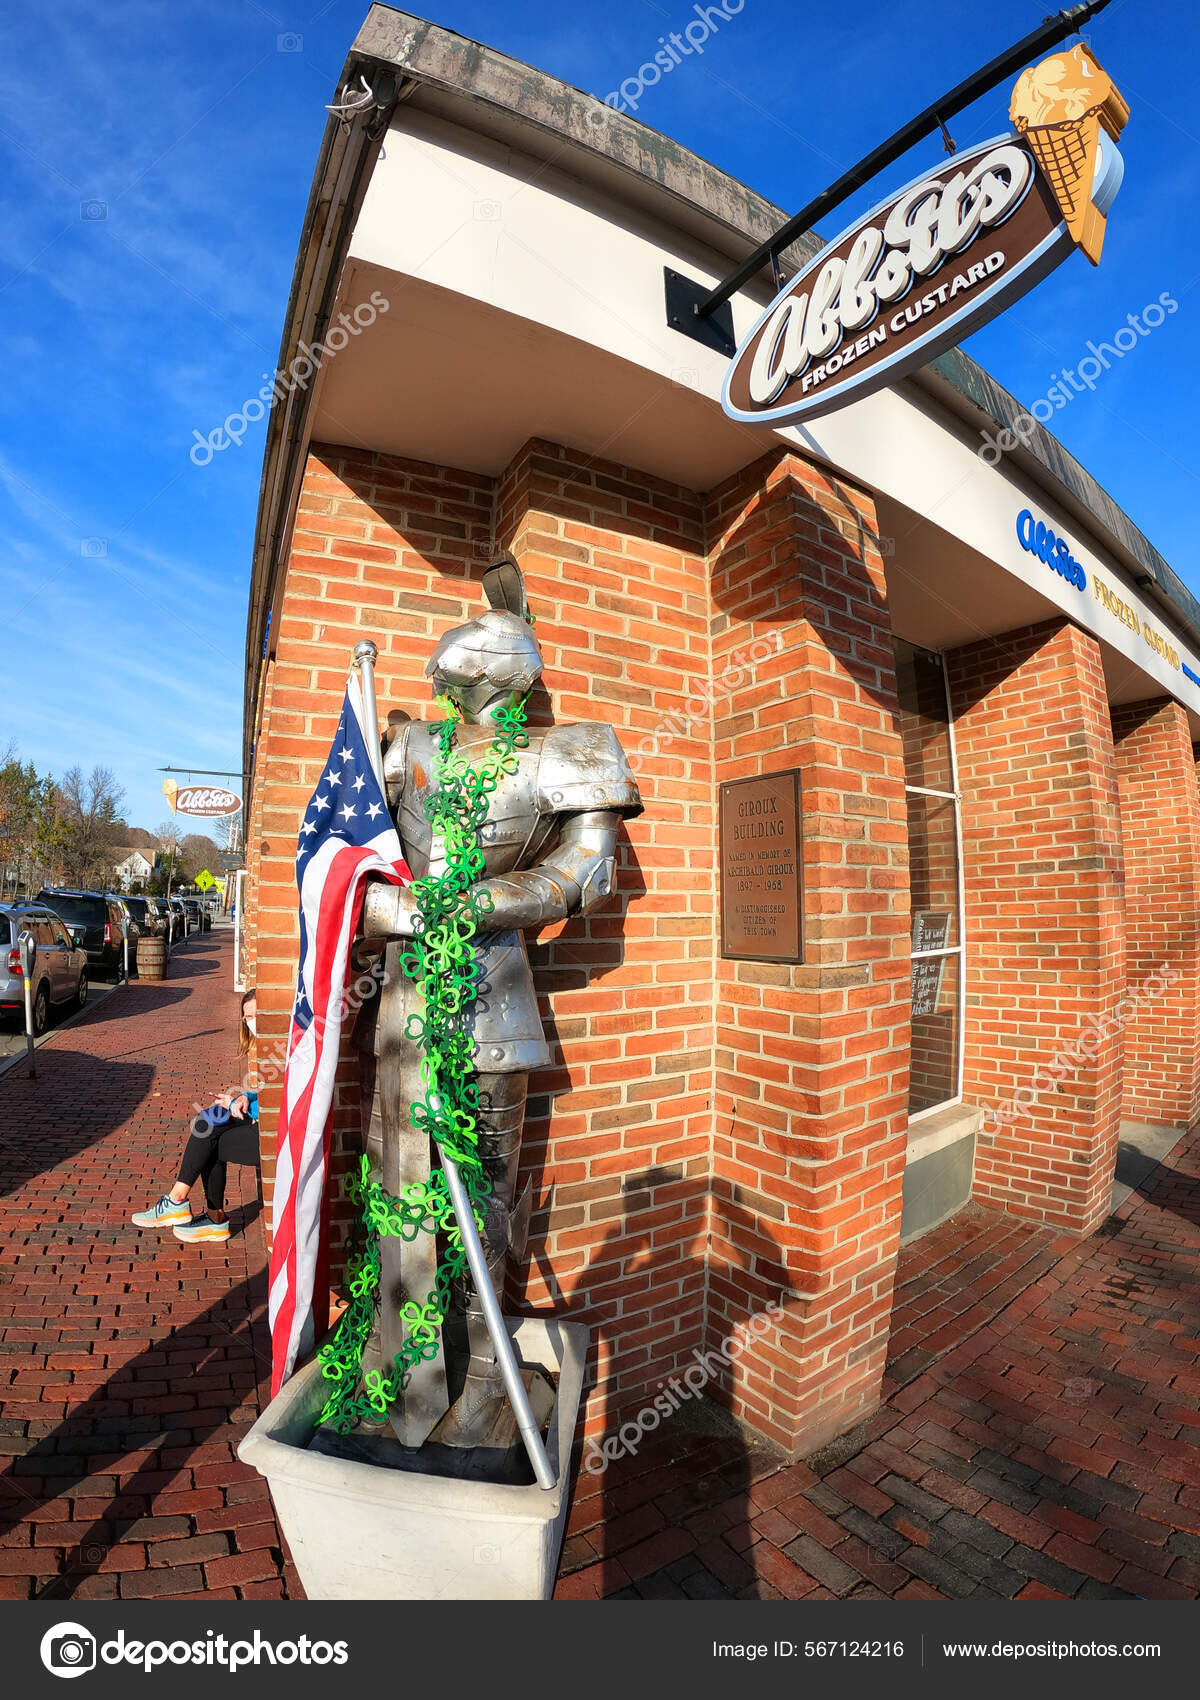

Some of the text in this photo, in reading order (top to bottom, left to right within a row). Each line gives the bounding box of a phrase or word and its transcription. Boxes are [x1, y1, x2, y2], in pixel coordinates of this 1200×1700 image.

[801, 250, 1007, 393] FROZEN CUSTARD
[1090, 573, 1141, 637] FROZEN
[738, 797, 778, 818] GIROUX
[733, 820, 785, 841] BUILDING
[728, 848, 791, 862] NAMED IN MEMORY OF
[728, 863, 794, 878] ARCHIBALD GIROUX
[743, 915, 777, 925] CITIZEN OF
[743, 926, 777, 936] THIS TOWN
